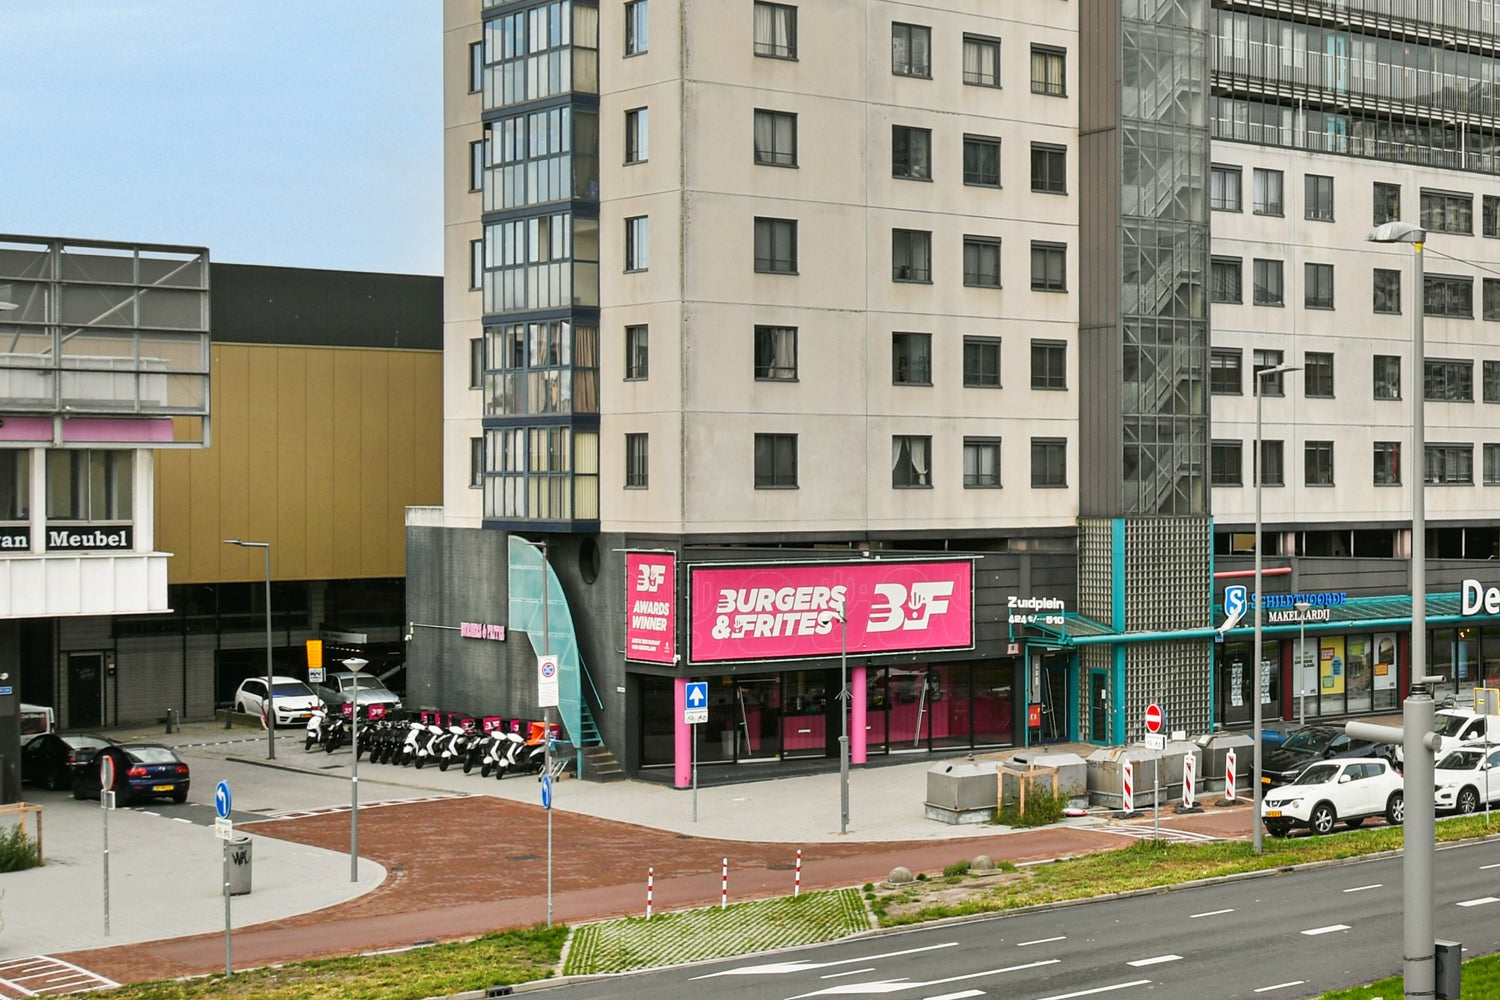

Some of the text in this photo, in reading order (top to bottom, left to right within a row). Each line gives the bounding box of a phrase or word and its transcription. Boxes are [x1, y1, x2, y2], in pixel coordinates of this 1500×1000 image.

[49, 530, 127, 547] Meubel
[716, 585, 847, 614] BURGERS
[1007, 596, 1065, 612] Zuidplein
[1461, 579, 1500, 616] De
[633, 600, 670, 616] AWARDS
[632, 616, 667, 632] WINNER
